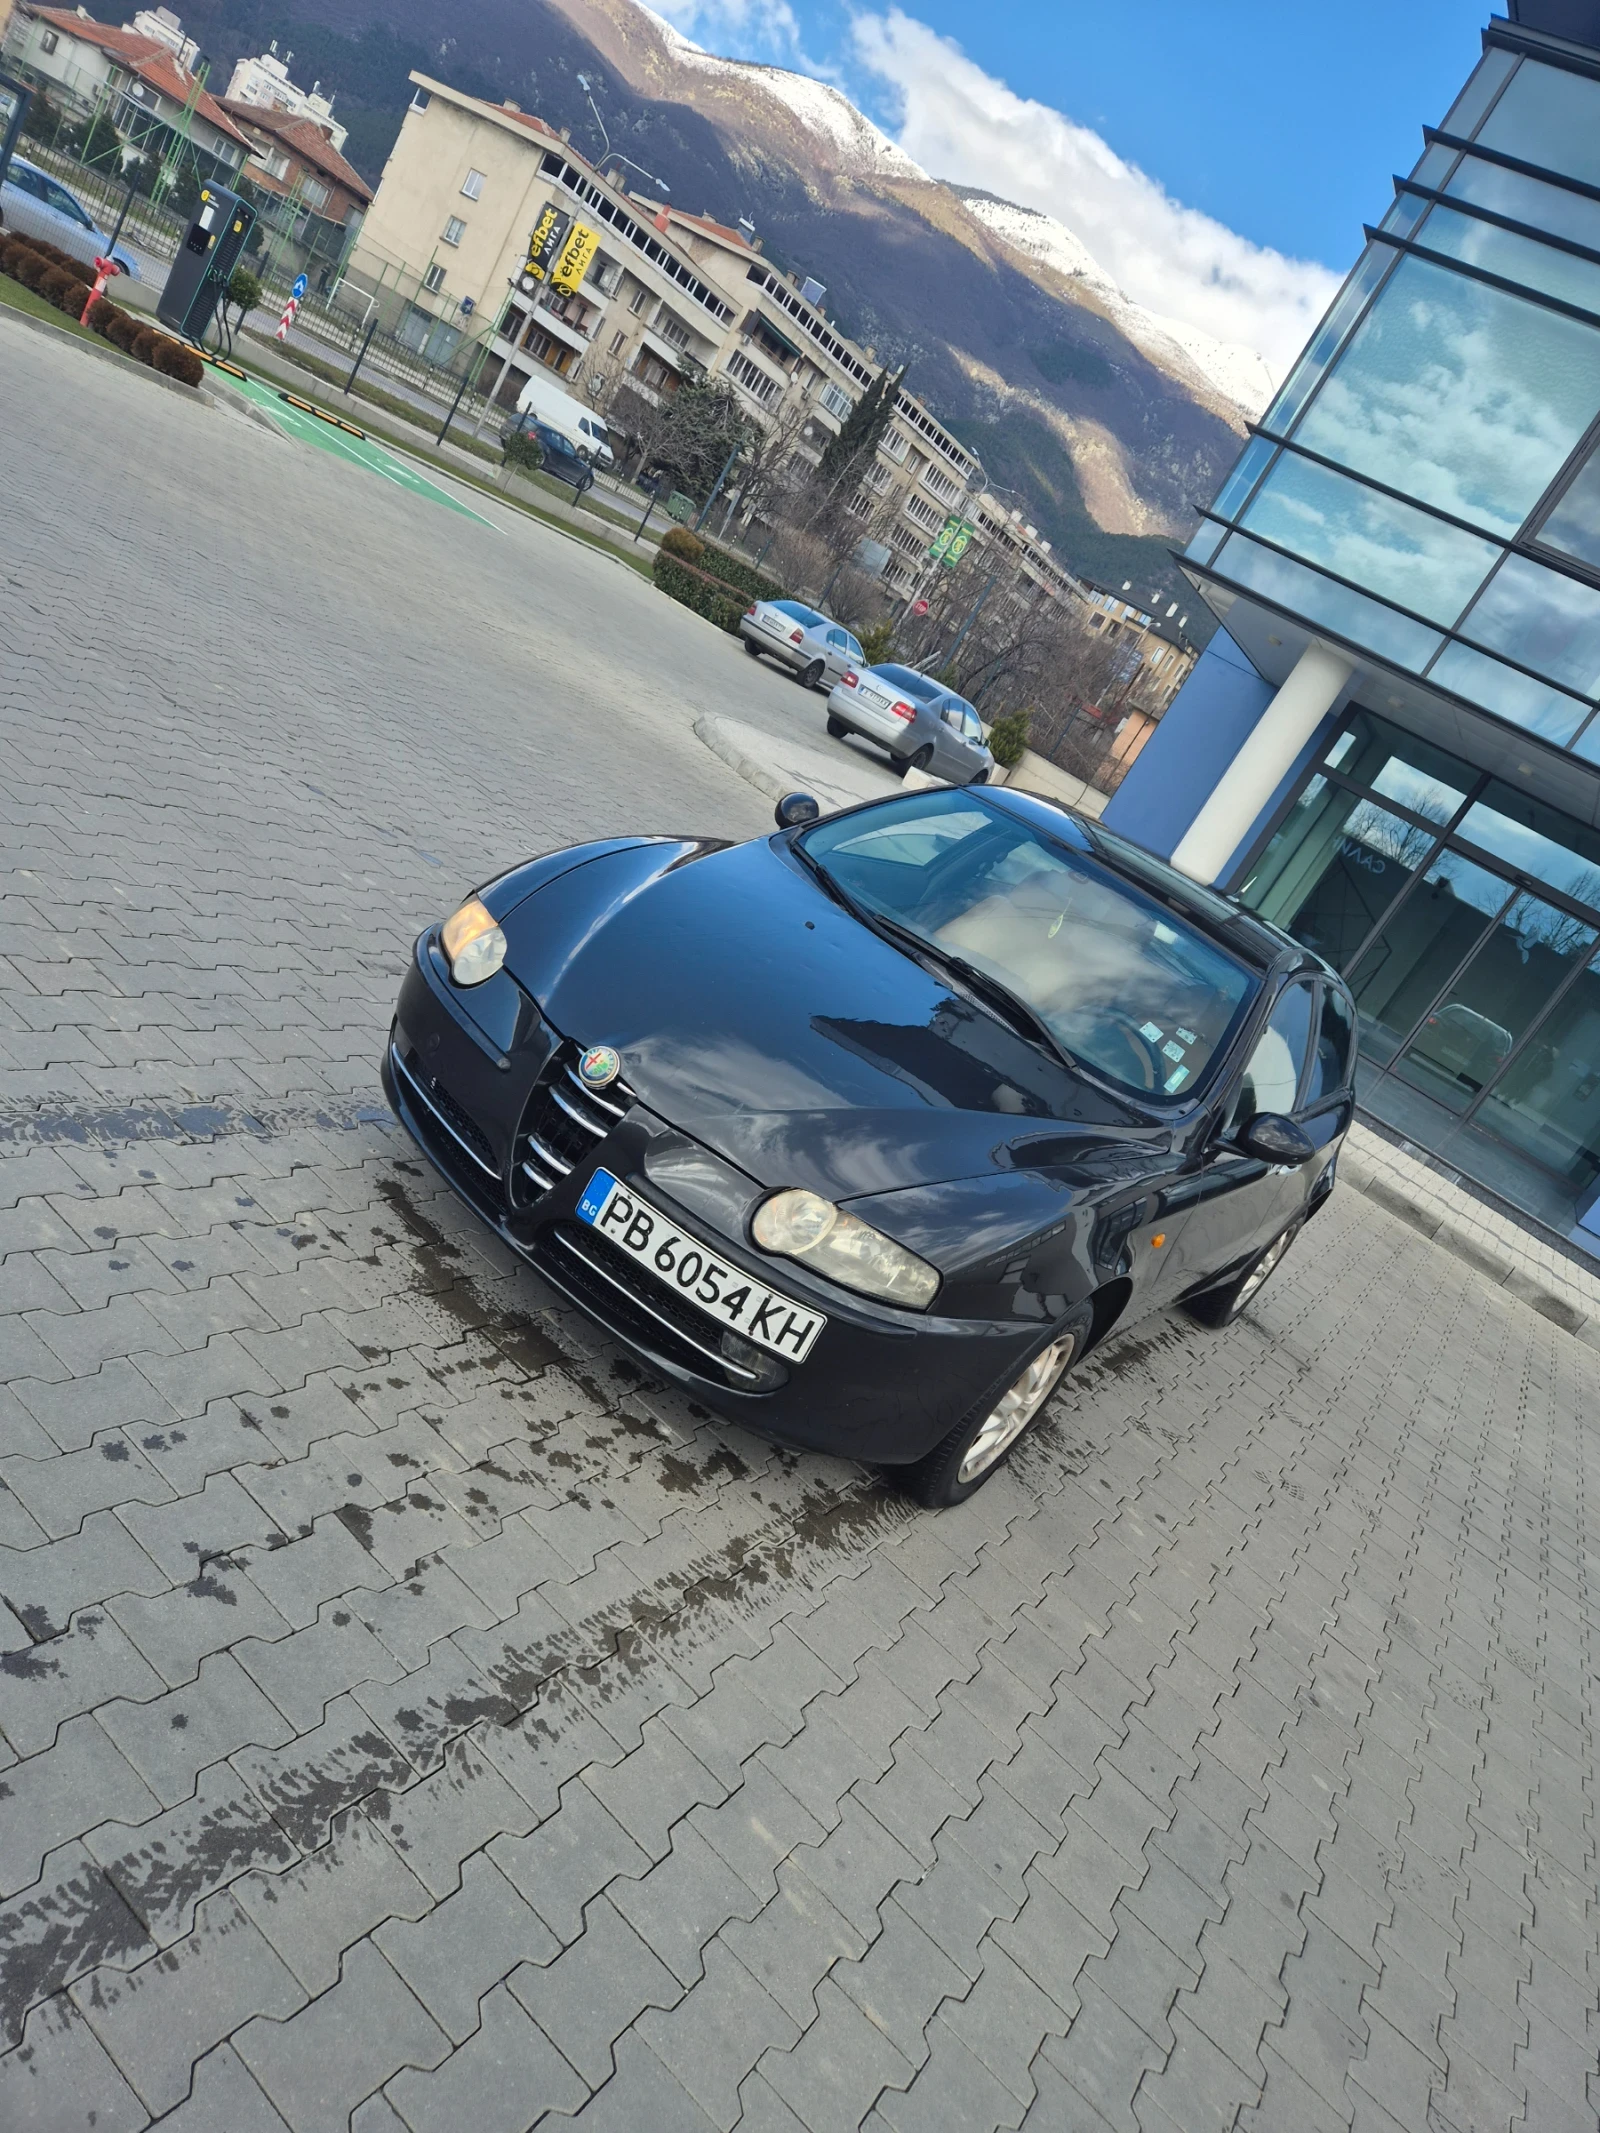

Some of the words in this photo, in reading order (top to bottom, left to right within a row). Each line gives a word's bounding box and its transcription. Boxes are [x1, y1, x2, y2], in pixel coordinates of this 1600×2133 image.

[531, 208, 558, 257] efbet
[544, 226, 561, 256] ЛИГА
[561, 229, 589, 278] efbet
[576, 247, 592, 275] ЛИГА
[581, 1199, 598, 1217] BG
[600, 1192, 655, 1251] PB
[654, 1236, 752, 1321] 6054
[748, 1297, 816, 1354] KH
